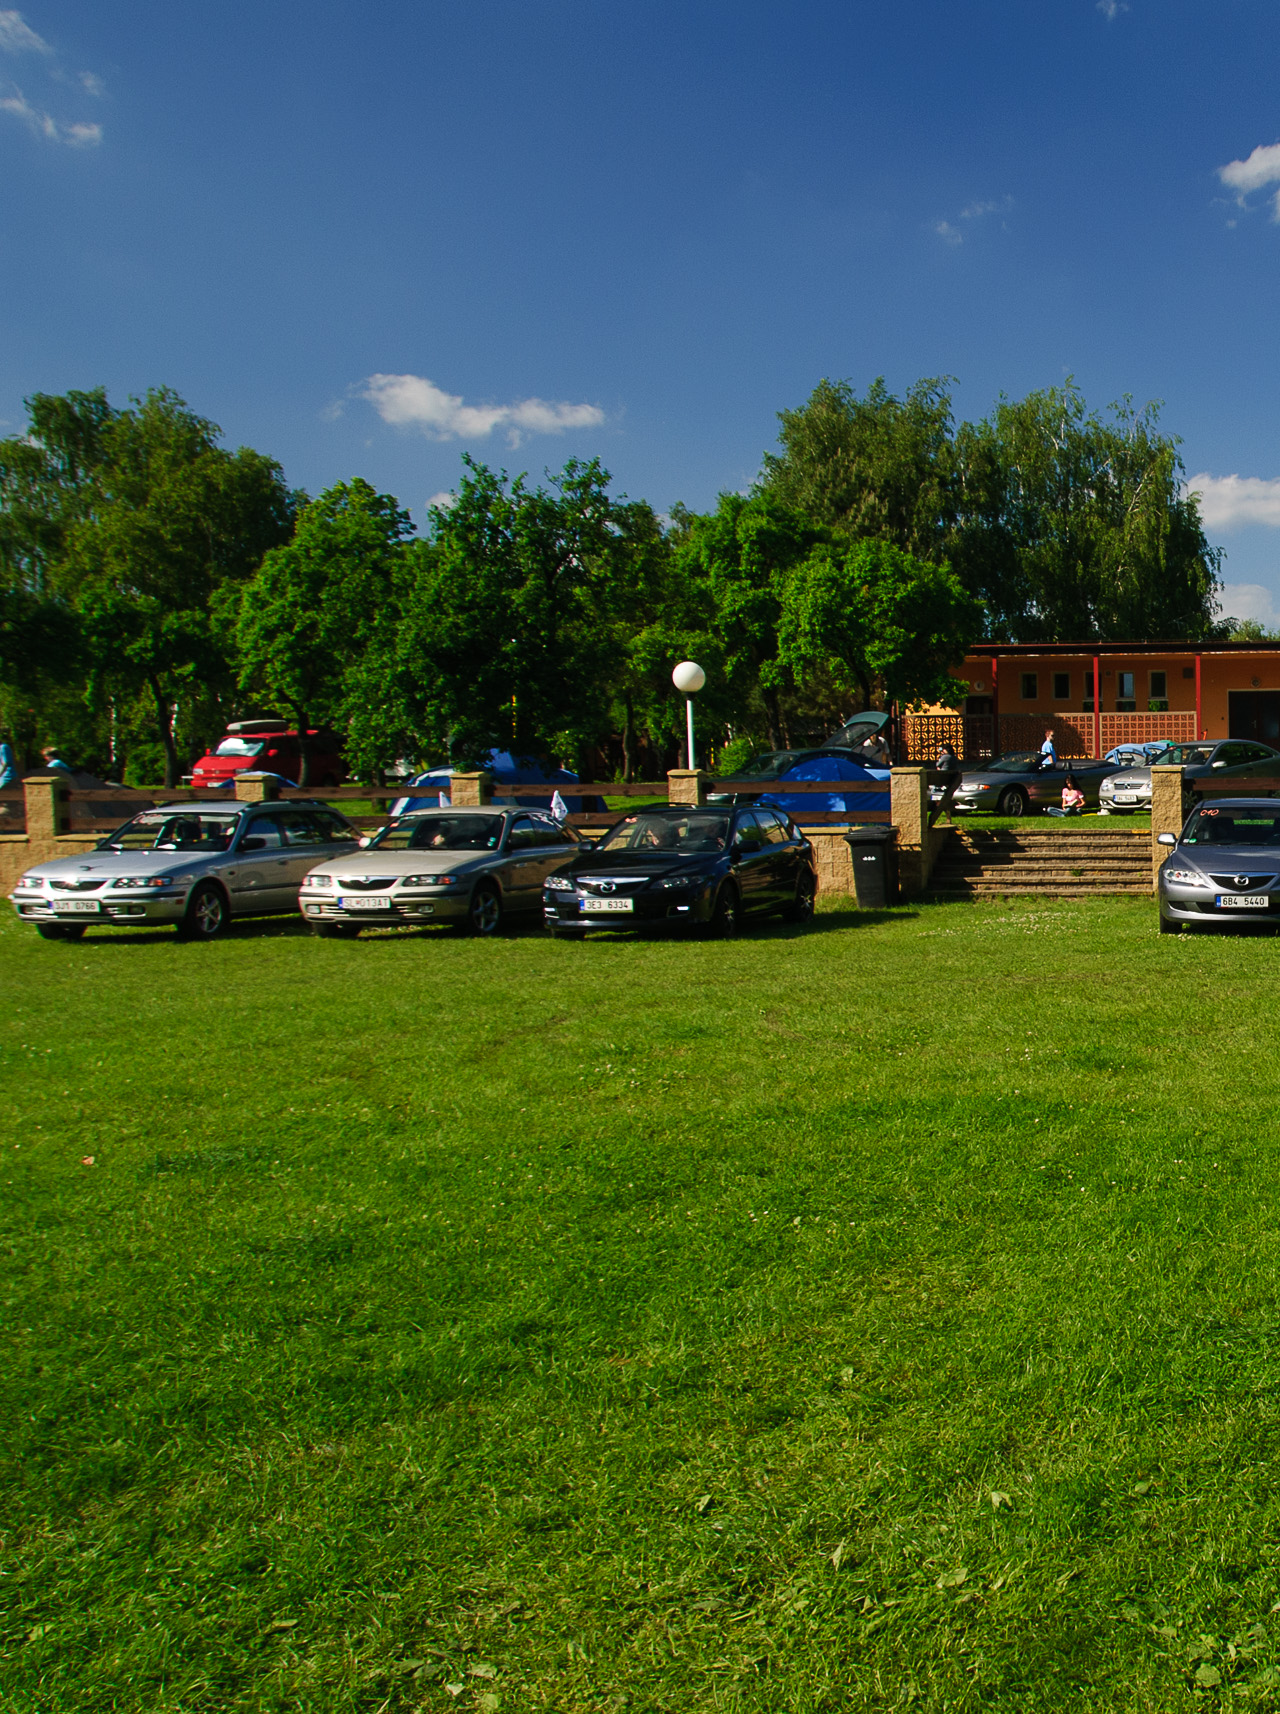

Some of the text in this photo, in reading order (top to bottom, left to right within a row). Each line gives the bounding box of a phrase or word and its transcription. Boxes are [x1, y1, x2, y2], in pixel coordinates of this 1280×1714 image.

[587, 901, 629, 909] 3E3 6334
[1223, 897, 1265, 905] 6B4 5440
[55, 902, 70, 910] 3J1
